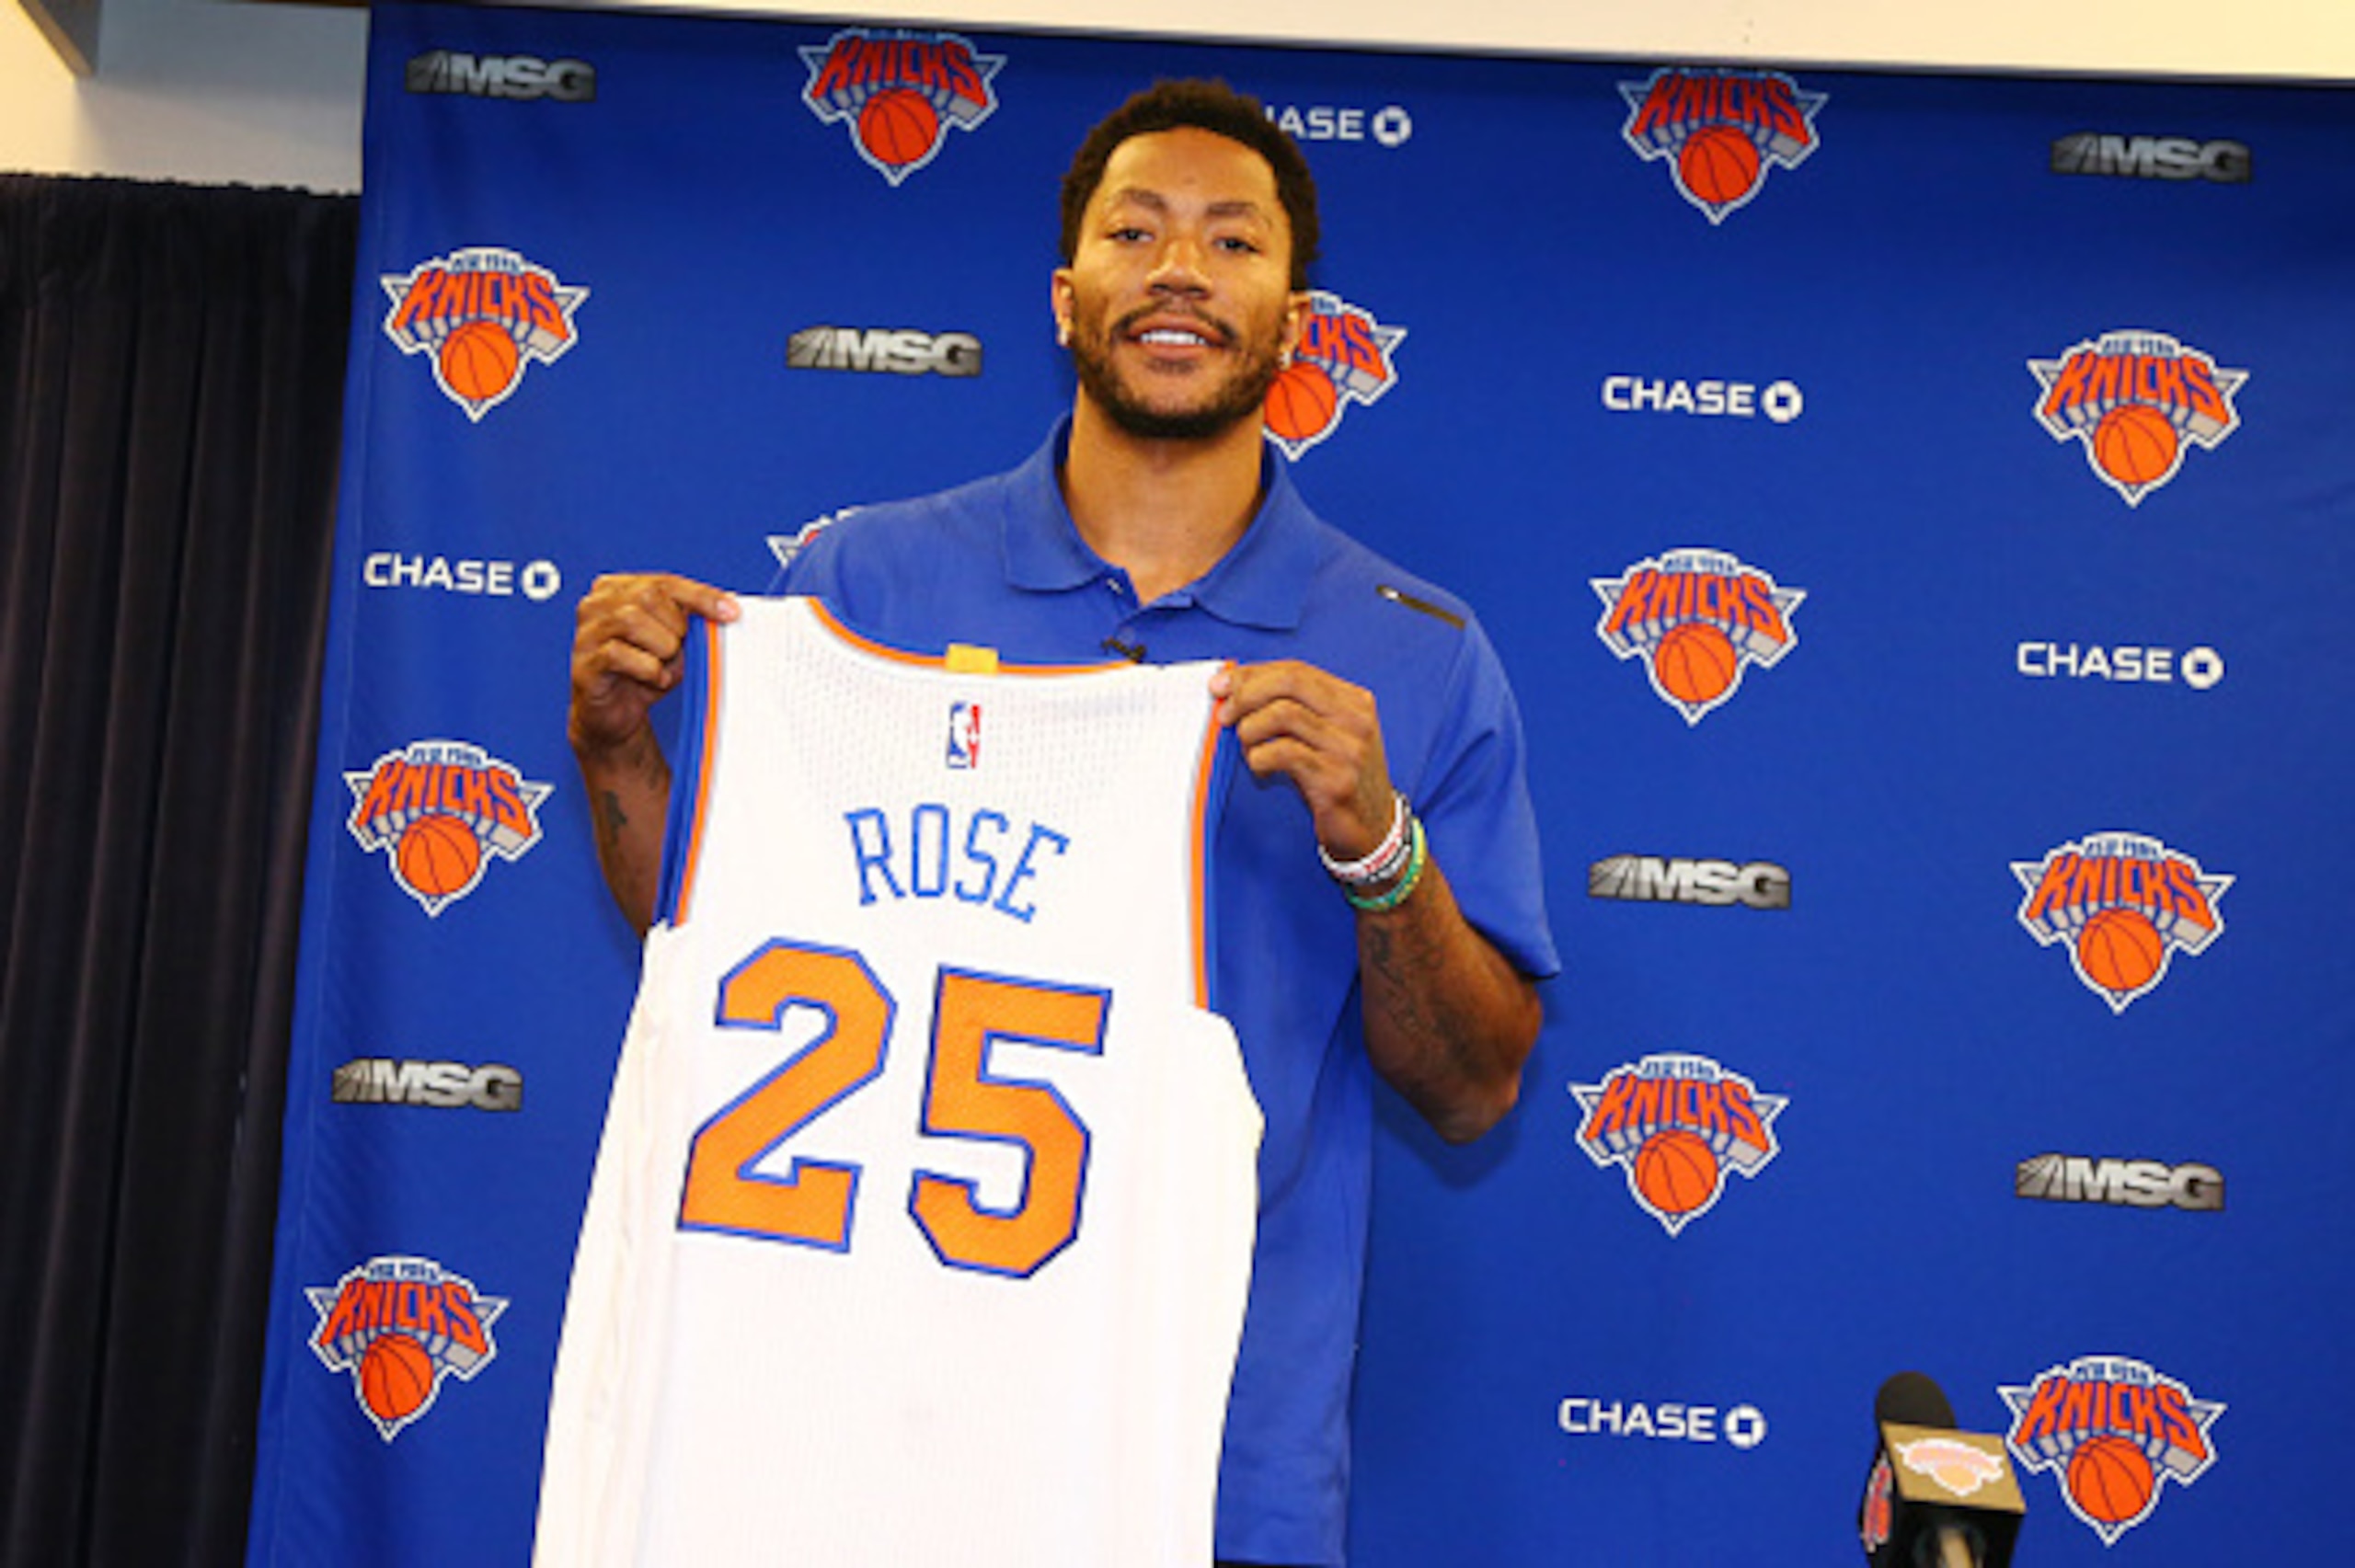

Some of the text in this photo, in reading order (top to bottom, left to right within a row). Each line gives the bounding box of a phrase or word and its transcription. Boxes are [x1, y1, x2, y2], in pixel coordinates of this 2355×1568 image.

[449, 52, 596, 102] MSG
[812, 39, 987, 107] KNICKS
[1266, 106, 1364, 140] ASE
[1632, 76, 1810, 145] KNICKS
[2099, 134, 2249, 184] MSG
[391, 269, 570, 341] KNICKS
[835, 327, 982, 376] MSG
[1603, 376, 1756, 416] CHASE
[2043, 351, 2231, 426] KNICKS
[363, 553, 514, 596] CHASE
[1605, 569, 1788, 645] KNICKS
[2017, 642, 2174, 682] CHASE
[355, 761, 534, 839] KNICKS
[844, 804, 1071, 923] ROSE
[1639, 856, 1790, 910] MSG
[2027, 854, 2215, 931] KNICKS
[372, 1058, 523, 1111] MSG
[678, 937, 1113, 1280] 25
[1584, 1074, 1770, 1152] KNICKS
[2065, 1157, 2224, 1210] MSG
[318, 1279, 488, 1356] KNICKS
[1558, 1398, 1717, 1442] CHASE
[2015, 1379, 2207, 1461] KNICKS
